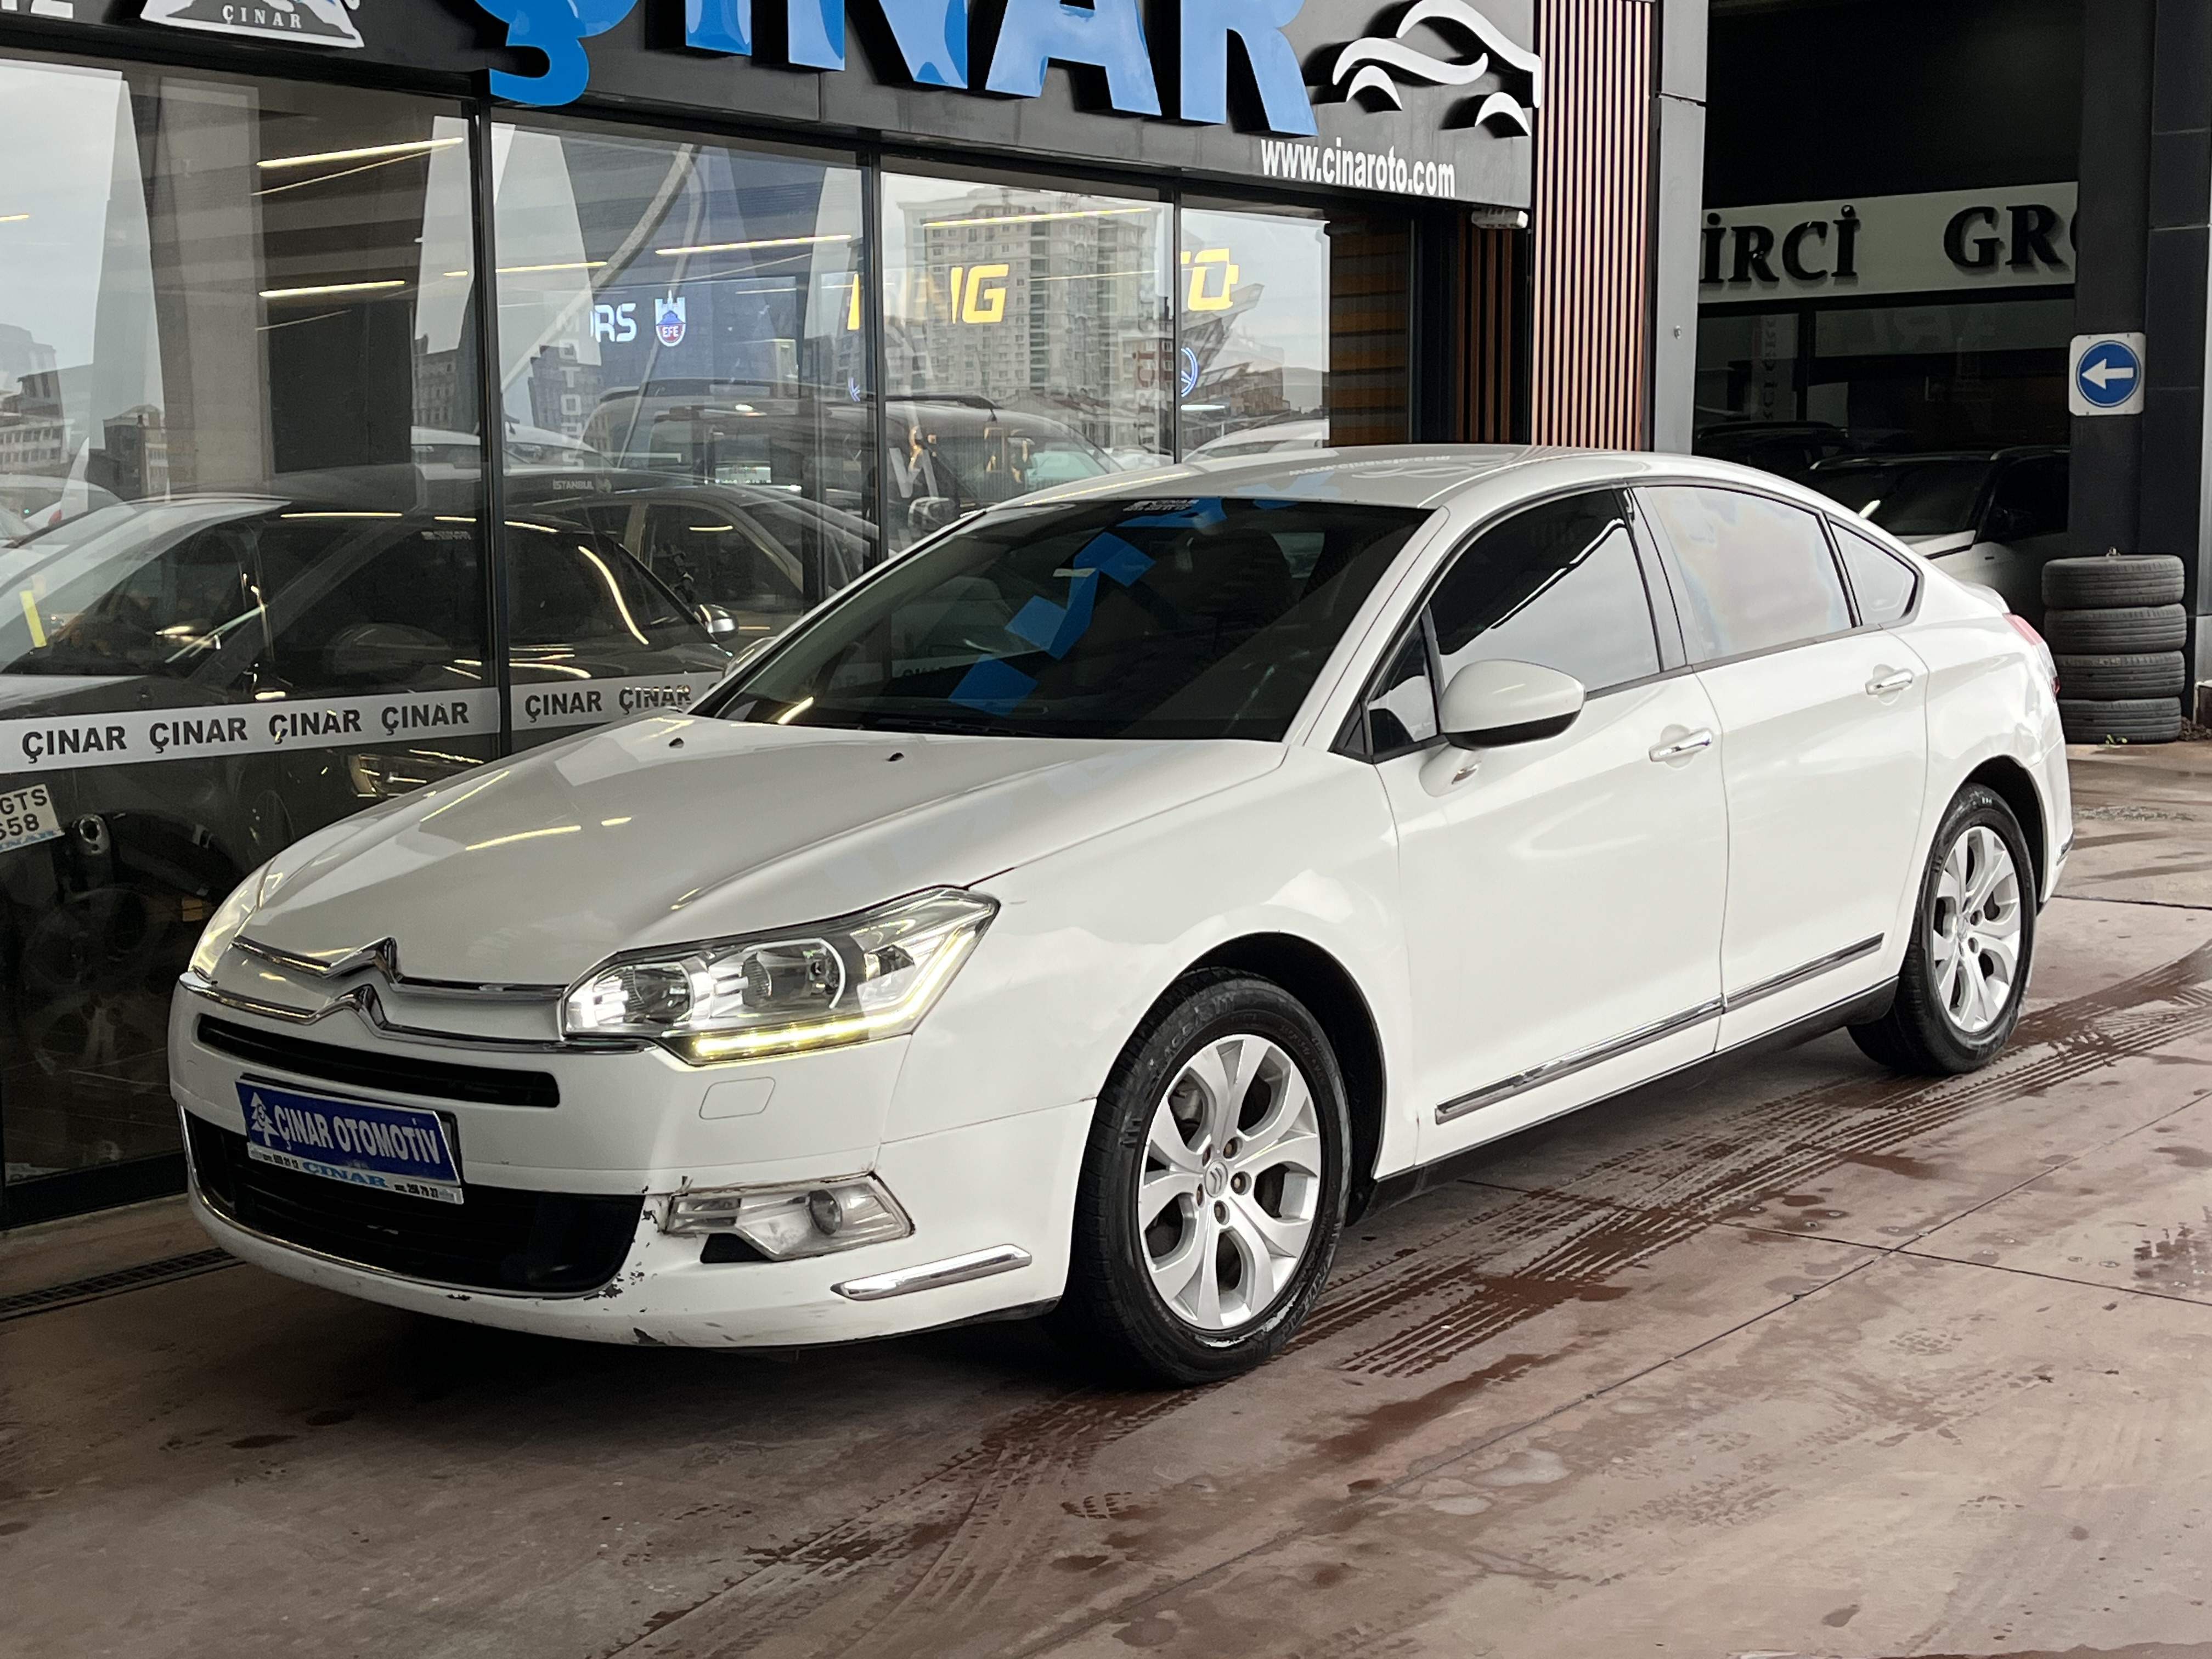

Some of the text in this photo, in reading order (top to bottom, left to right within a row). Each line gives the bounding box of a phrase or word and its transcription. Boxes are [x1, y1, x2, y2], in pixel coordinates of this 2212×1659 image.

[222, 4, 302, 28] ÇINAR
[1261, 137, 1455, 198] www.cinaroto.com
[1944, 204, 2077, 267] GR
[662, 326, 679, 337] EFE
[22, 685, 692, 764] ÇINAR ÇINAR ÇINAR ÇINAR ÇINAR ÇINAR
[0, 789, 47, 815] GTS
[274, 1104, 441, 1164] ÇINAR OTOMOTİV
